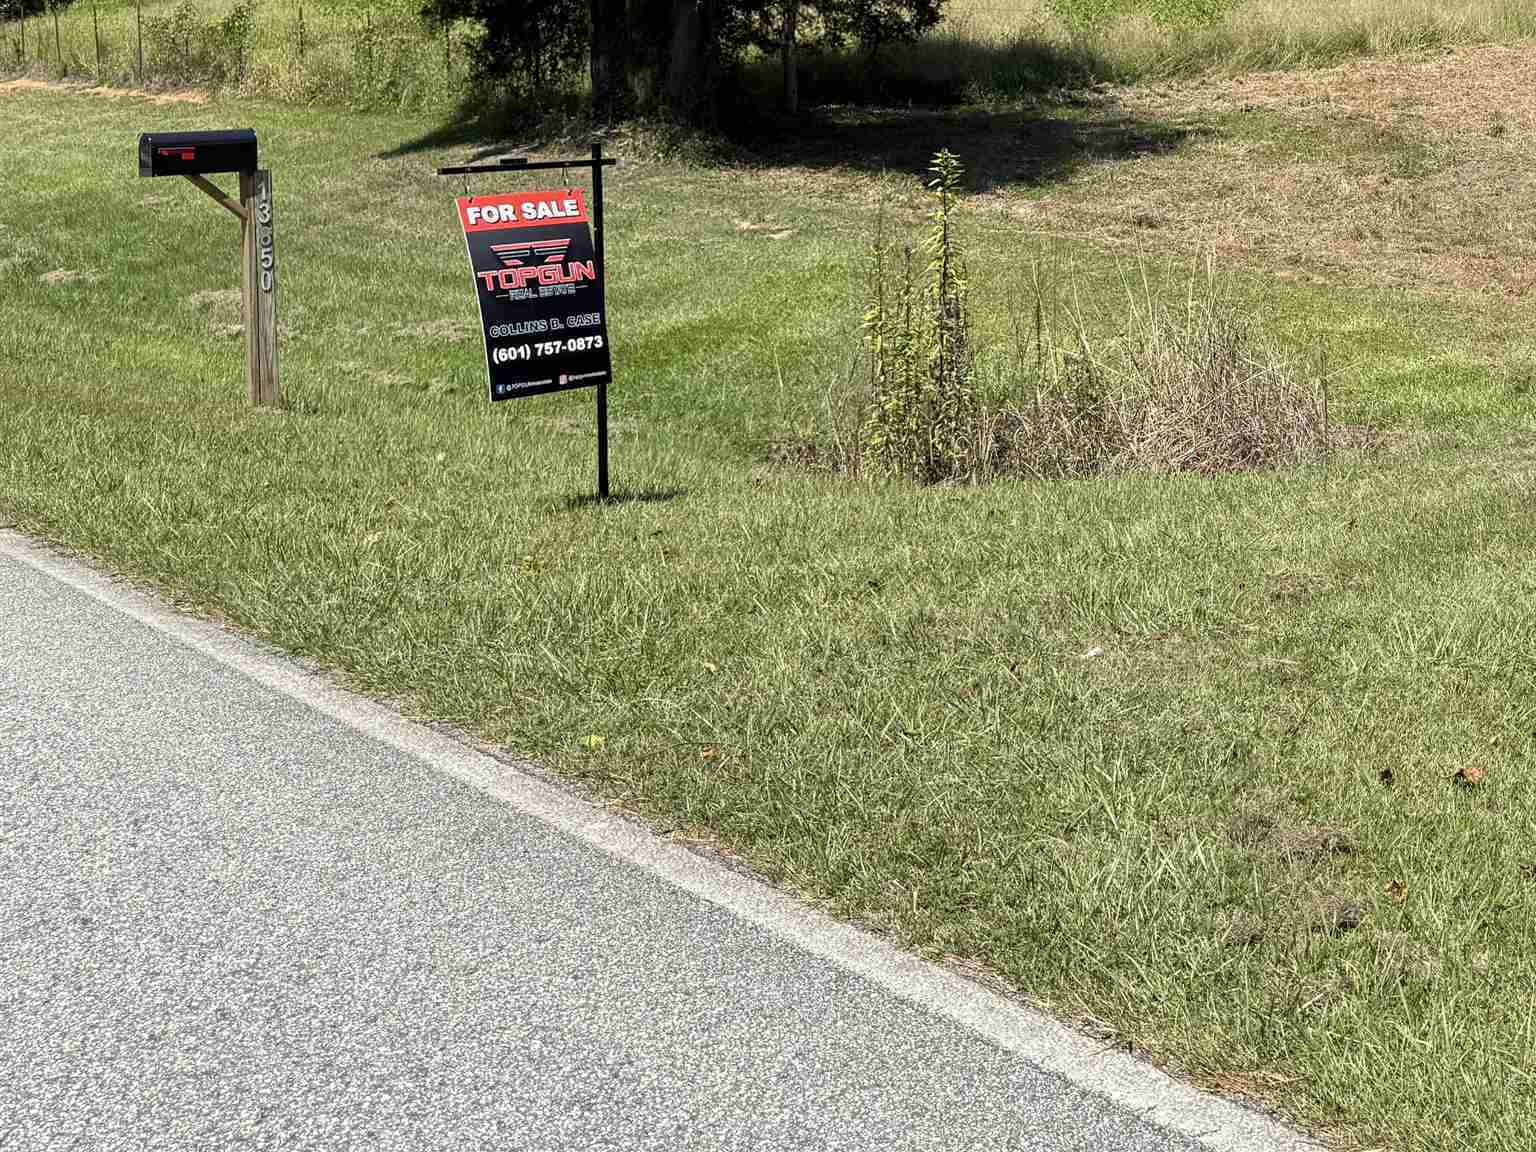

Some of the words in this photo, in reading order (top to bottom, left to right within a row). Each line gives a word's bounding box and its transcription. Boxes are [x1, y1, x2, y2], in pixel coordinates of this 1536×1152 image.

[466, 204, 518, 225] FOR
[521, 199, 580, 220] SALE
[477, 260, 596, 291] TOPGUN
[490, 320, 548, 338] COLLINS
[550, 318, 564, 330] B.
[566, 312, 601, 328] CASE
[492, 344, 531, 364] (601)
[534, 335, 603, 356] 757-0873
